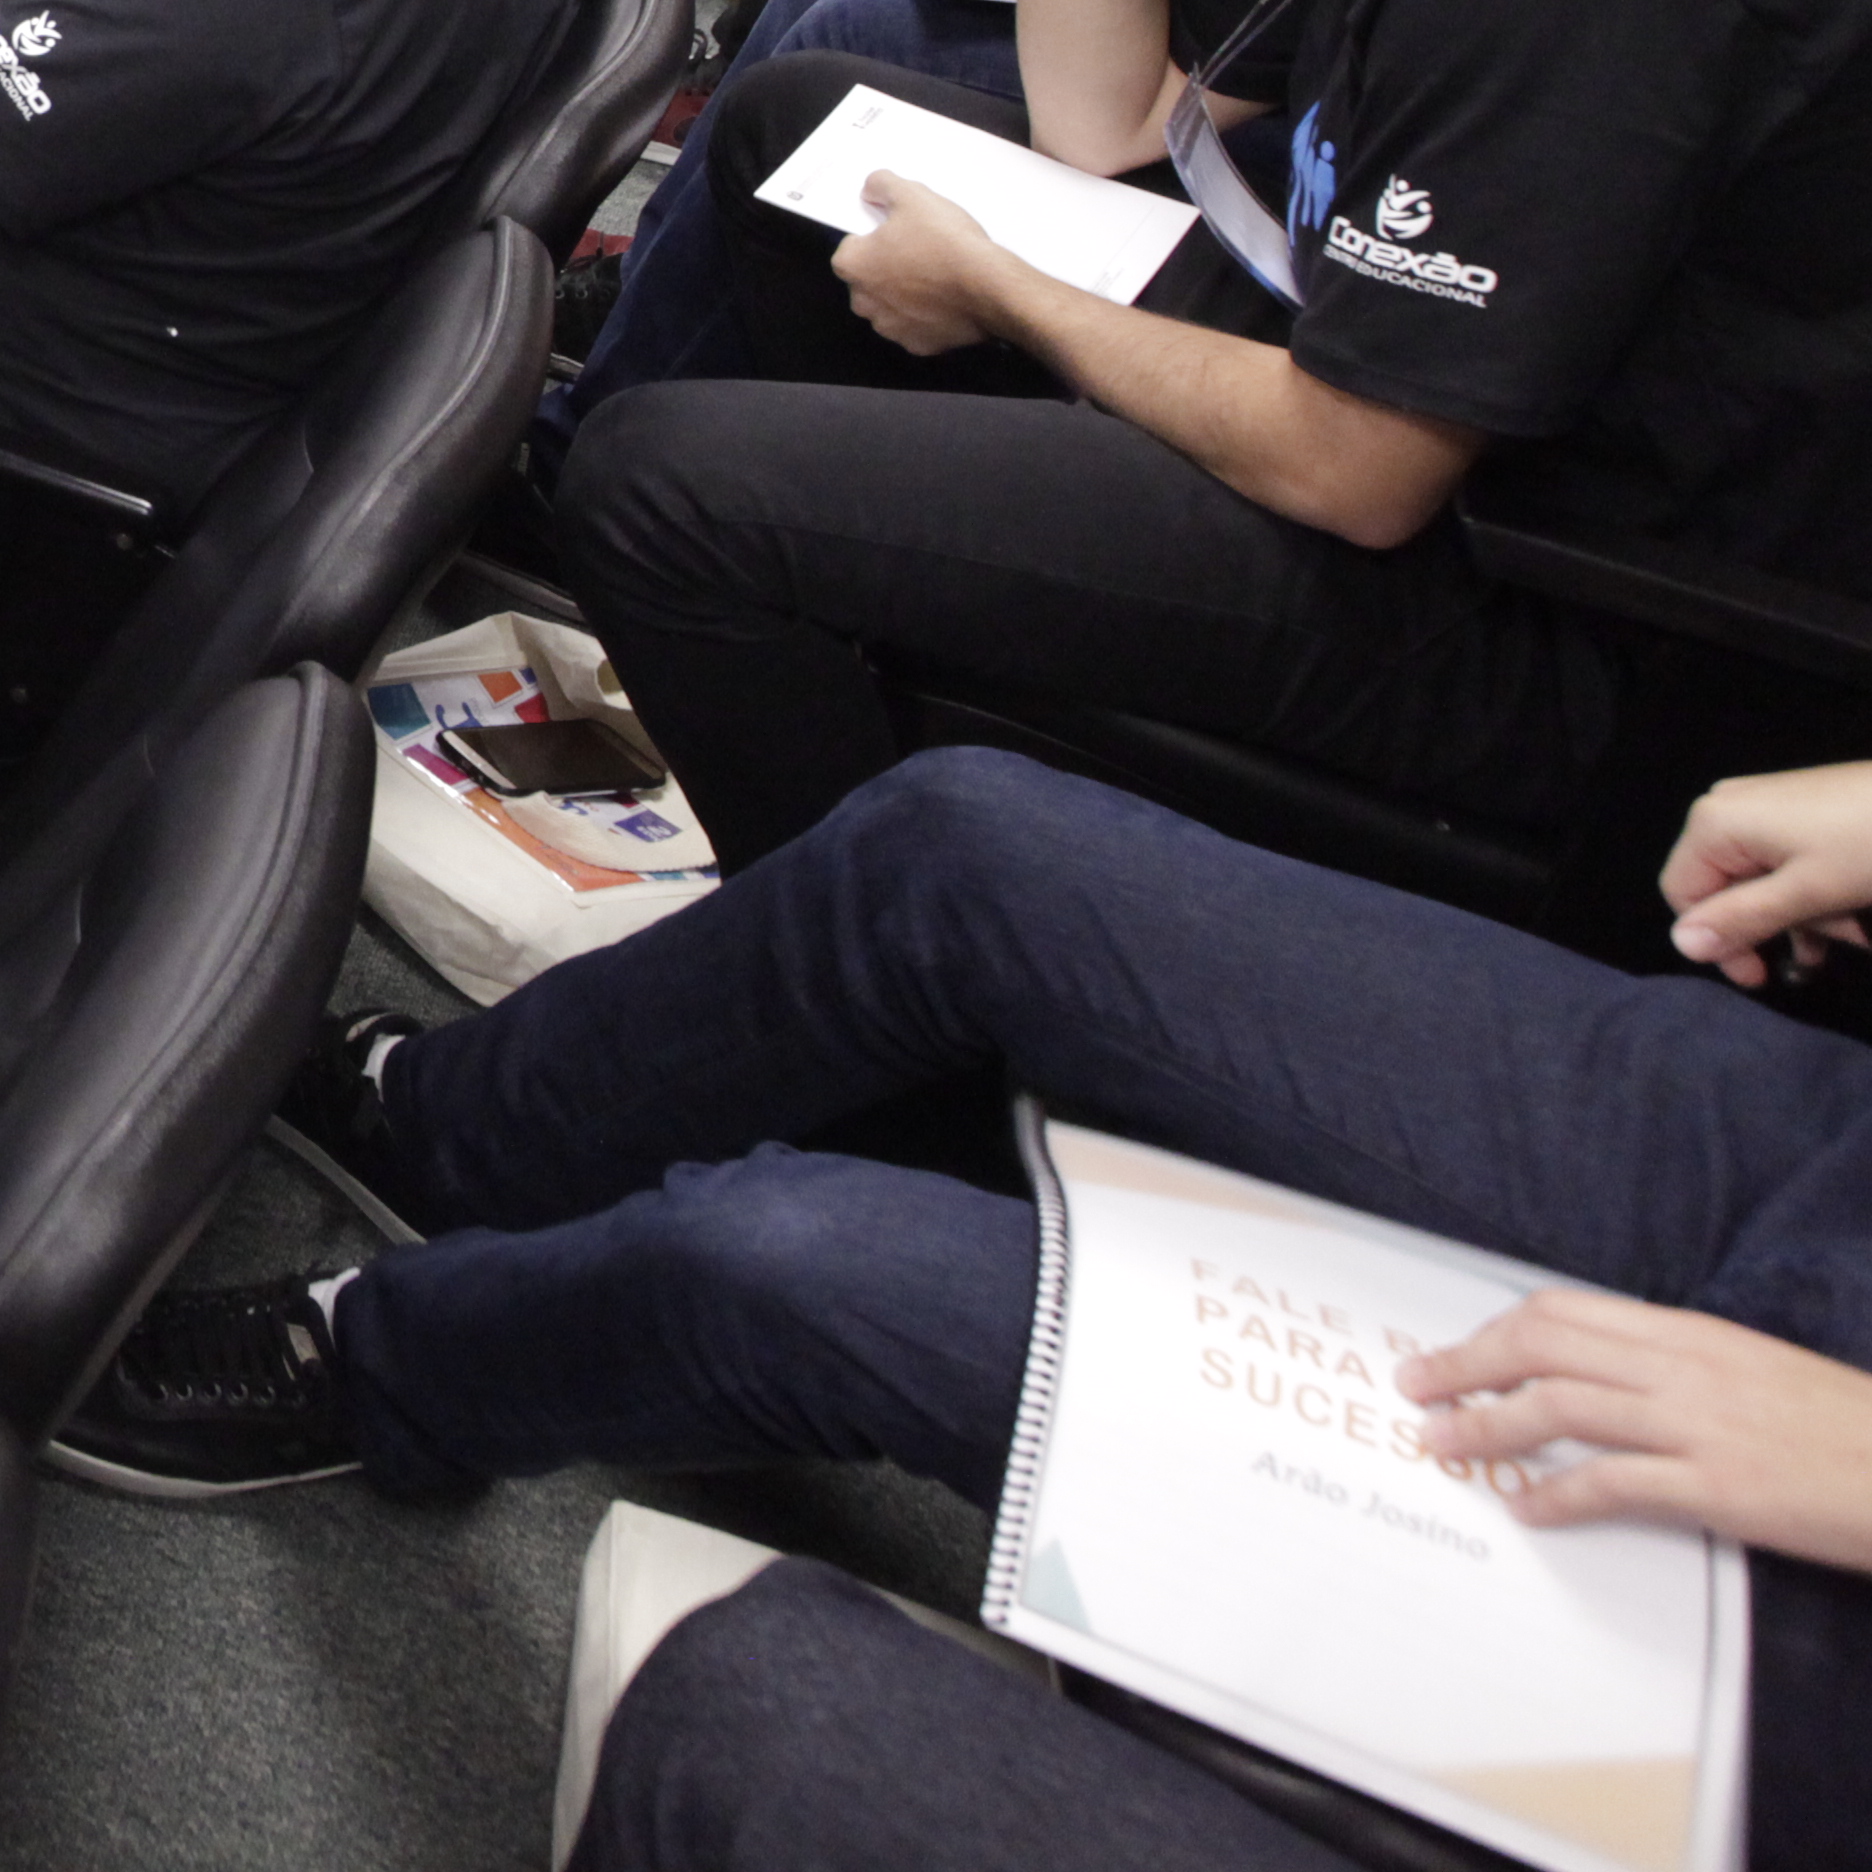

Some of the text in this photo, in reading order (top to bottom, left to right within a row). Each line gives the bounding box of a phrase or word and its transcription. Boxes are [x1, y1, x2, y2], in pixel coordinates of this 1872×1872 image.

[1328, 215, 1498, 293] Conexão
[1357, 262, 1487, 308] EDUCACIONAL
[1191, 1257, 1352, 1336] FALE
[1195, 1294, 1376, 1388] PARA
